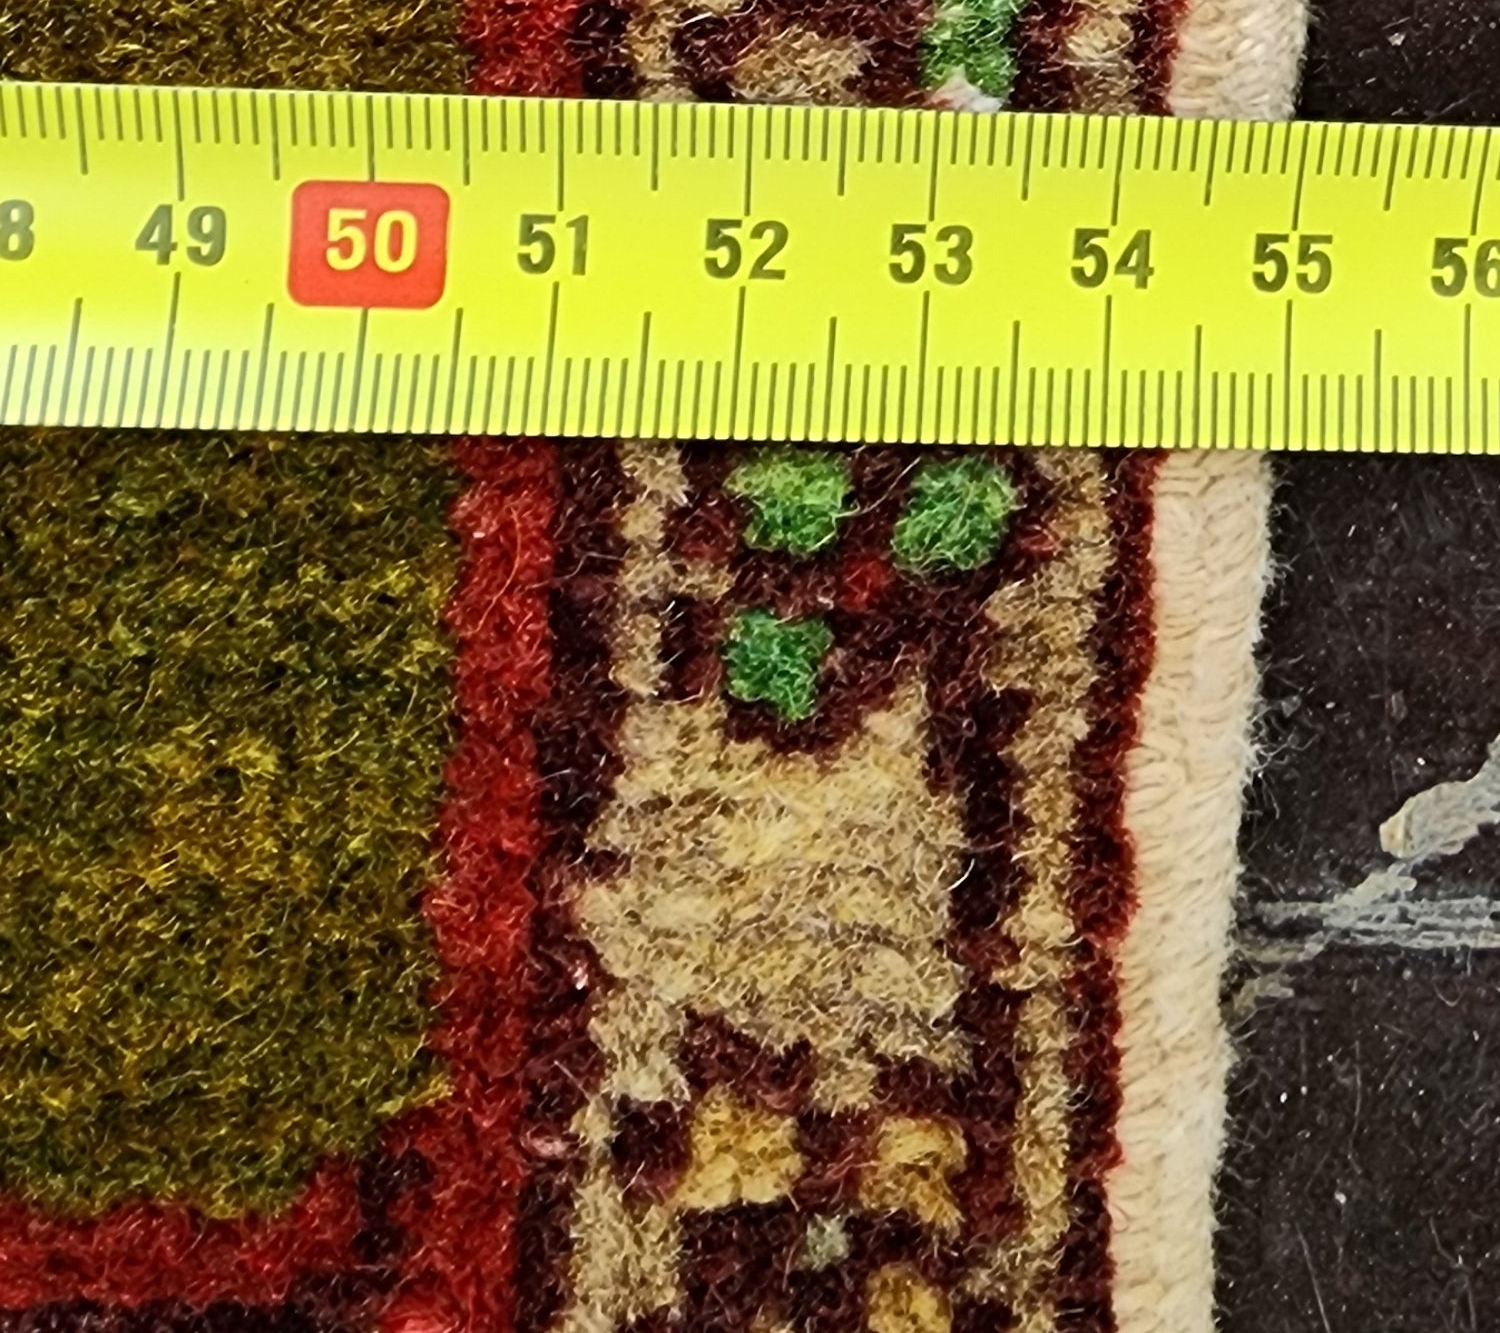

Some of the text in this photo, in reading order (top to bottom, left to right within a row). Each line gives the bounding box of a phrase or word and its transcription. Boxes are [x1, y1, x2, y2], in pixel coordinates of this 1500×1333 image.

[135, 203, 227, 268] 49
[325, 208, 419, 273] 50
[517, 213, 589, 277] 51
[703, 218, 789, 282] 52
[888, 223, 974, 287] 53
[1071, 228, 1155, 290] 54
[1252, 233, 1334, 295] 55
